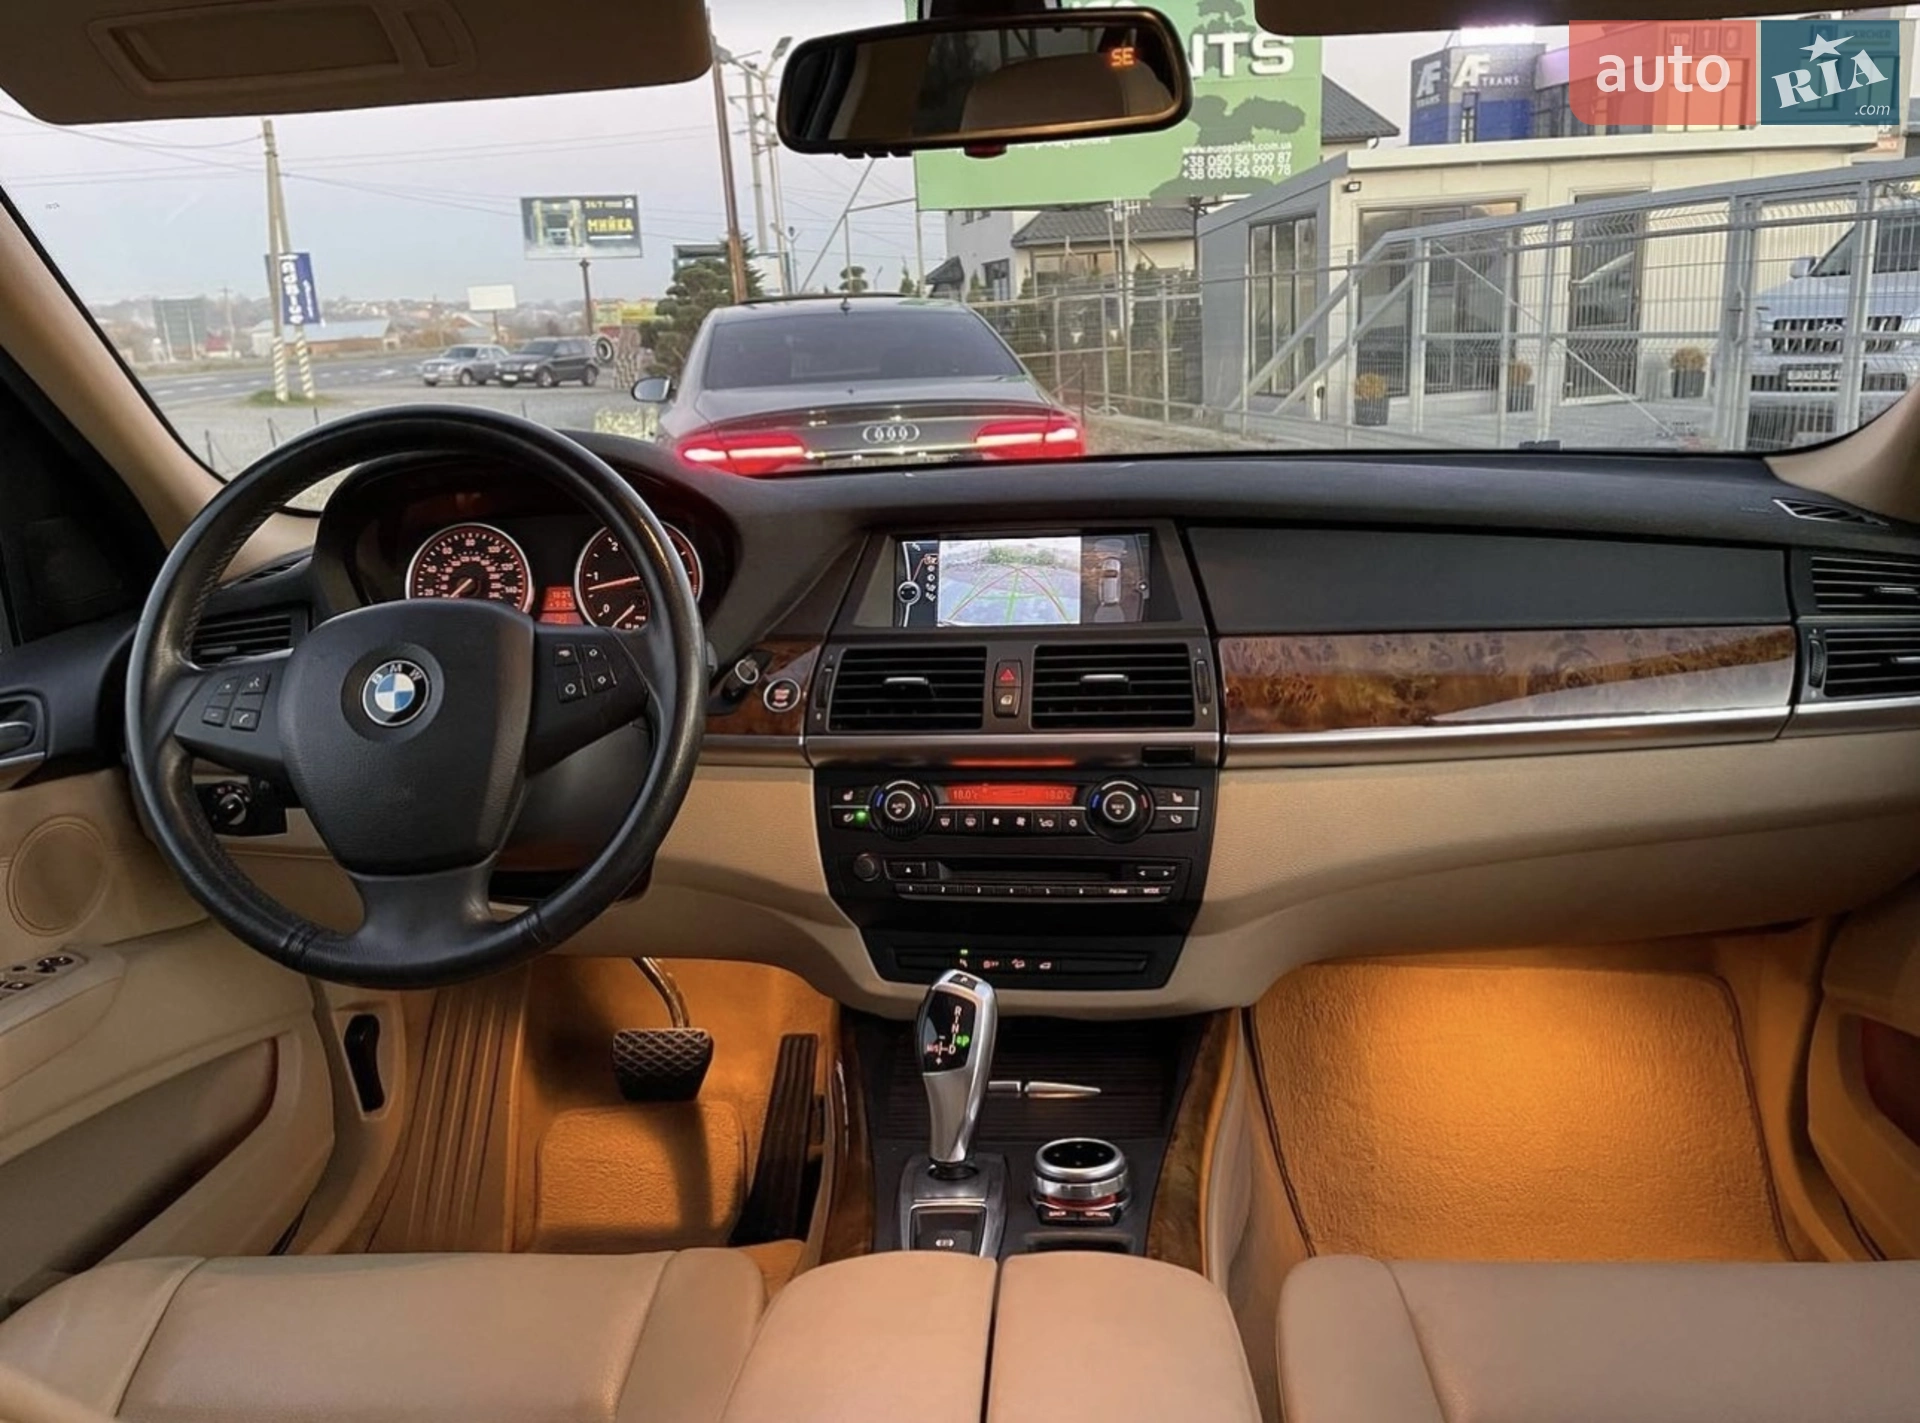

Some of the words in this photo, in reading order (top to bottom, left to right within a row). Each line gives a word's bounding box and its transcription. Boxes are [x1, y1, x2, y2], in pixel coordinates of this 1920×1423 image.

[1111, 48, 1134, 66] SE
[1481, 75, 1520, 86] TRANS
[1207, 154, 1232, 167] 050
[1234, 153, 1250, 165] 56
[1252, 152, 1275, 164] 999
[1207, 166, 1232, 179] 050
[1234, 165, 1250, 178] 56
[1252, 164, 1275, 177] 999
[611, 542, 618, 551] 2
[603, 604, 610, 613] 0
[371, 664, 422, 684] BMW
[954, 1006, 962, 1016] R
[952, 1024, 959, 1033] N
[948, 1045, 956, 1055] D
